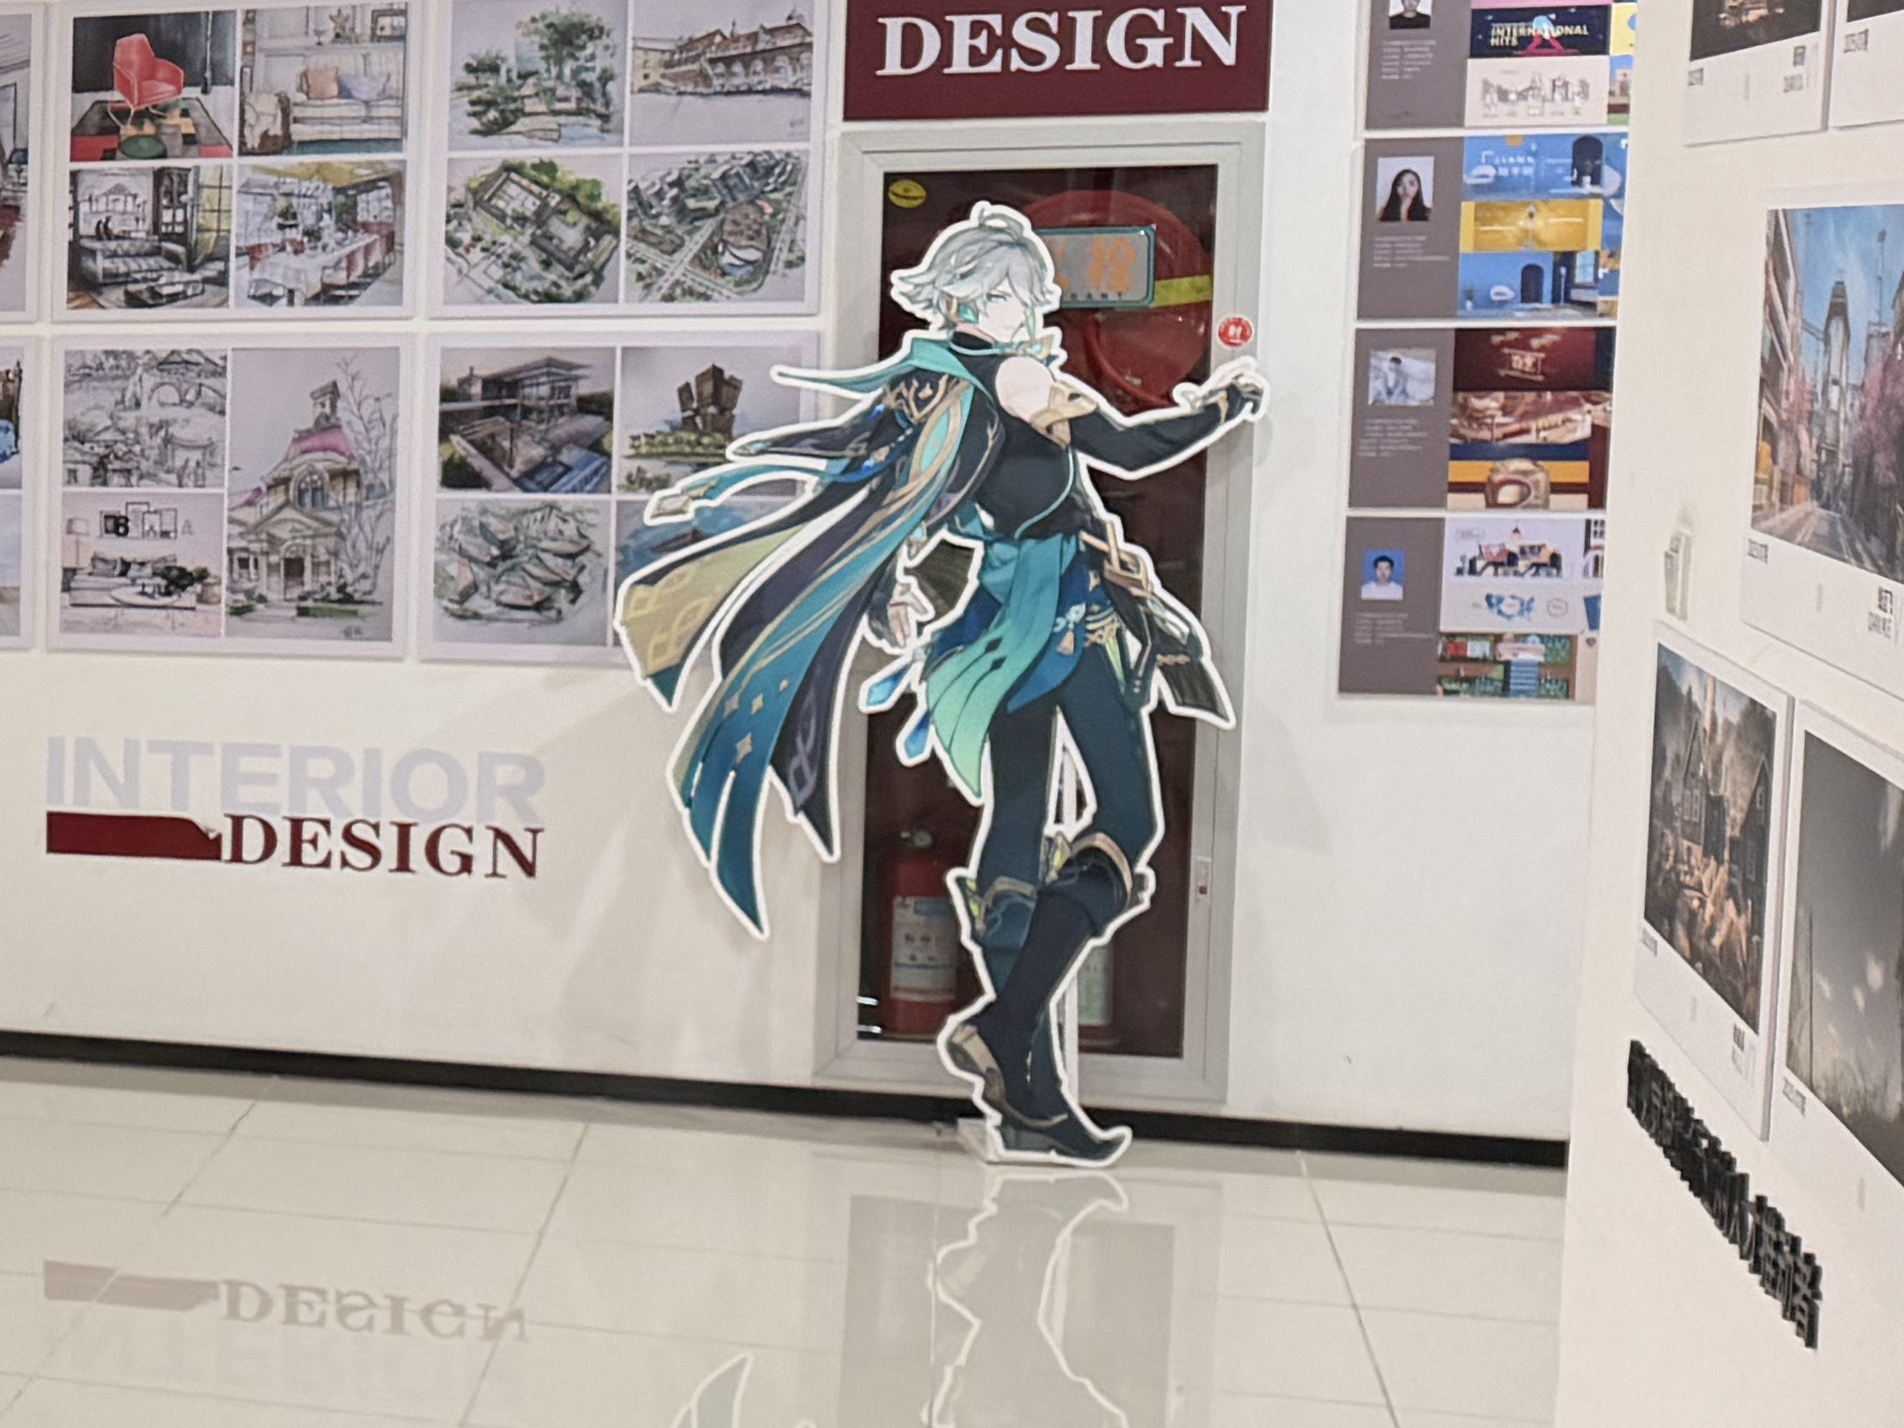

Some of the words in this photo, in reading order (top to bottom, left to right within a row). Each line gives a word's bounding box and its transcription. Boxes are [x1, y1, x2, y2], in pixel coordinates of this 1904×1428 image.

[876, 5, 1246, 76] DESIGN
[45, 735, 547, 826] INTERIOR
[224, 812, 546, 880] DESIGN
